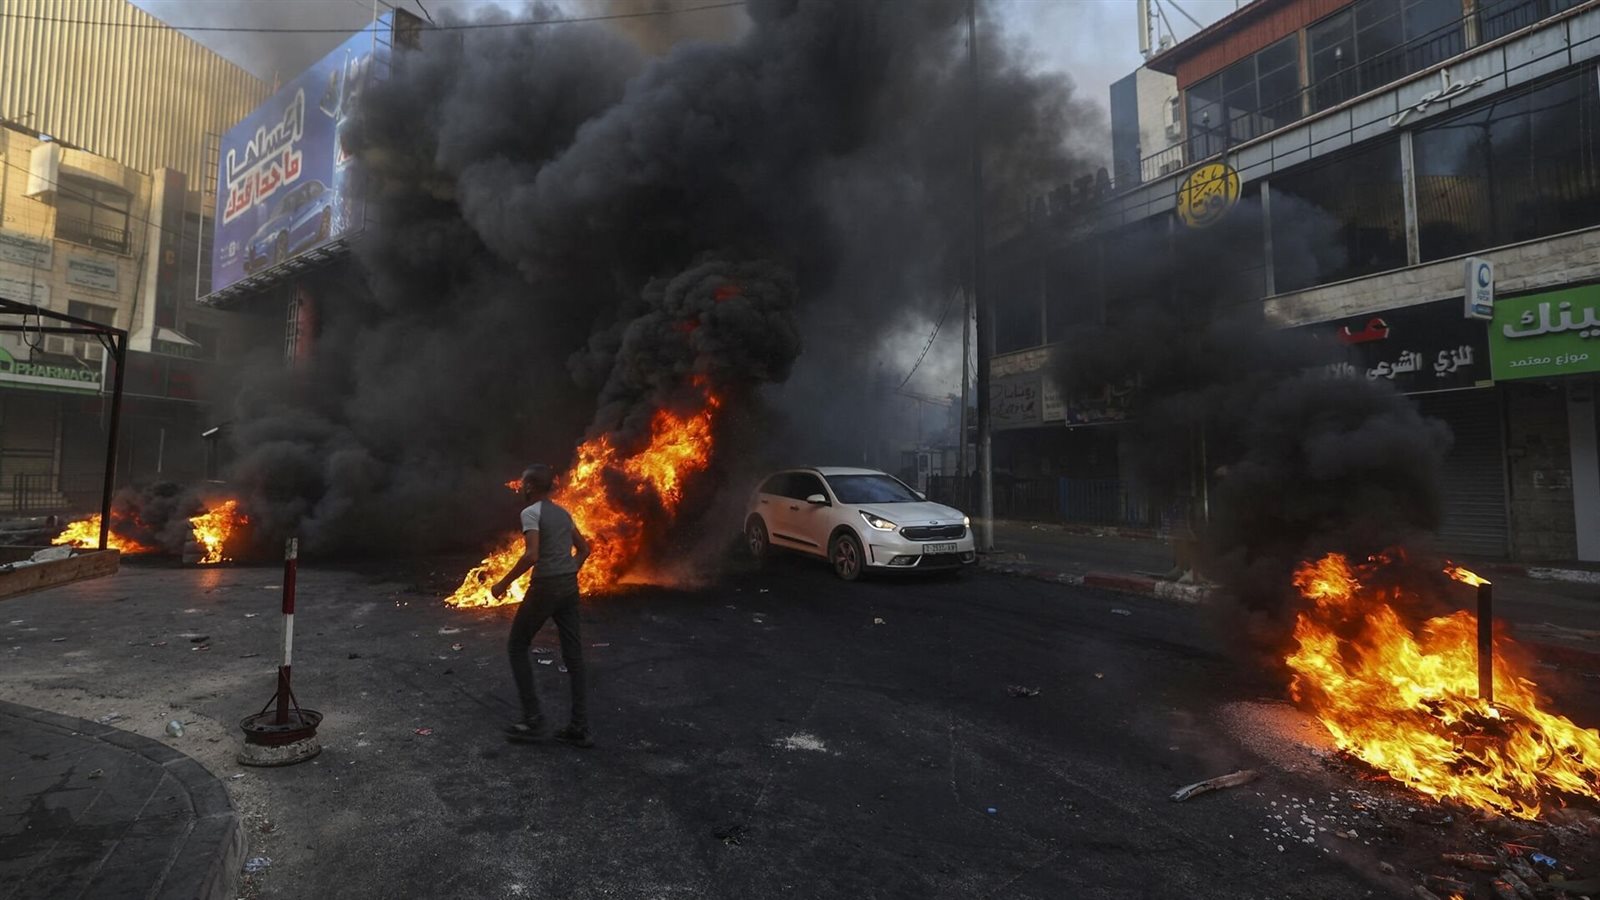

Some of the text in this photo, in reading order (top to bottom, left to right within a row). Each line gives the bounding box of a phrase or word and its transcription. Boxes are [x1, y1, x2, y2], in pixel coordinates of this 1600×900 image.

[1503, 301, 1600, 338] ينك
[16, 363, 99, 383] PHARMACY
[1433, 345, 1474, 377] للزي
[1509, 352, 1589, 368] موزع معتمد
